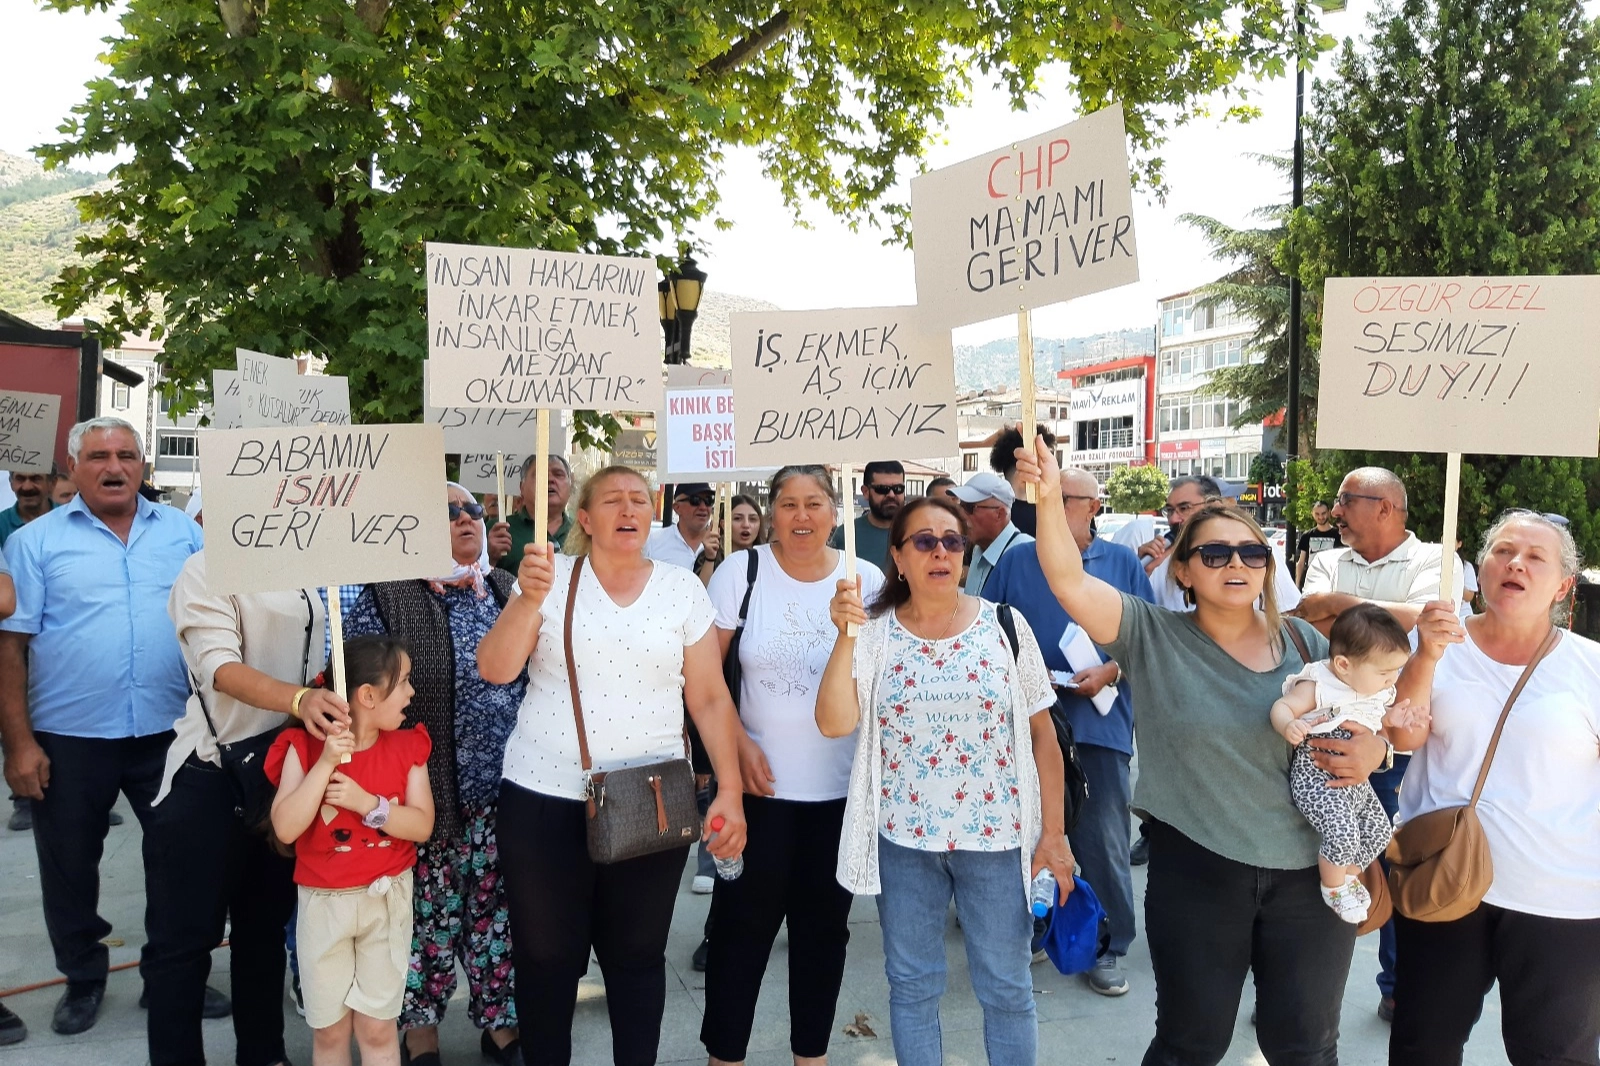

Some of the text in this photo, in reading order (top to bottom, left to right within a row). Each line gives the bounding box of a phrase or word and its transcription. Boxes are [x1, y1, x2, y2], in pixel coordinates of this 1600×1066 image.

[987, 138, 1071, 199] CHP
[970, 178, 1104, 251] MAMAMI
[529, 257, 646, 298] HAKLARINI
[458, 289, 542, 323] İNKAR
[1353, 279, 1546, 314] ÖZGÜR ÖZEL
[436, 320, 577, 353] İNSANLIĞA
[1354, 318, 1520, 357] SESİMİZİ
[500, 351, 612, 377] MEYDAN
[802, 362, 932, 400] AŞ İÇİN
[1101, 392, 1136, 407] REKLAM
[1362, 361, 1529, 405] DUY!!!
[669, 395, 711, 416] KINIK
[692, 422, 735, 447] BAŞK
[226, 433, 389, 476] BABAMIN
[231, 507, 325, 551] GERİ
[920, 673, 963, 685] Love
[912, 690, 974, 704] Always
[925, 711, 973, 723] Wins
